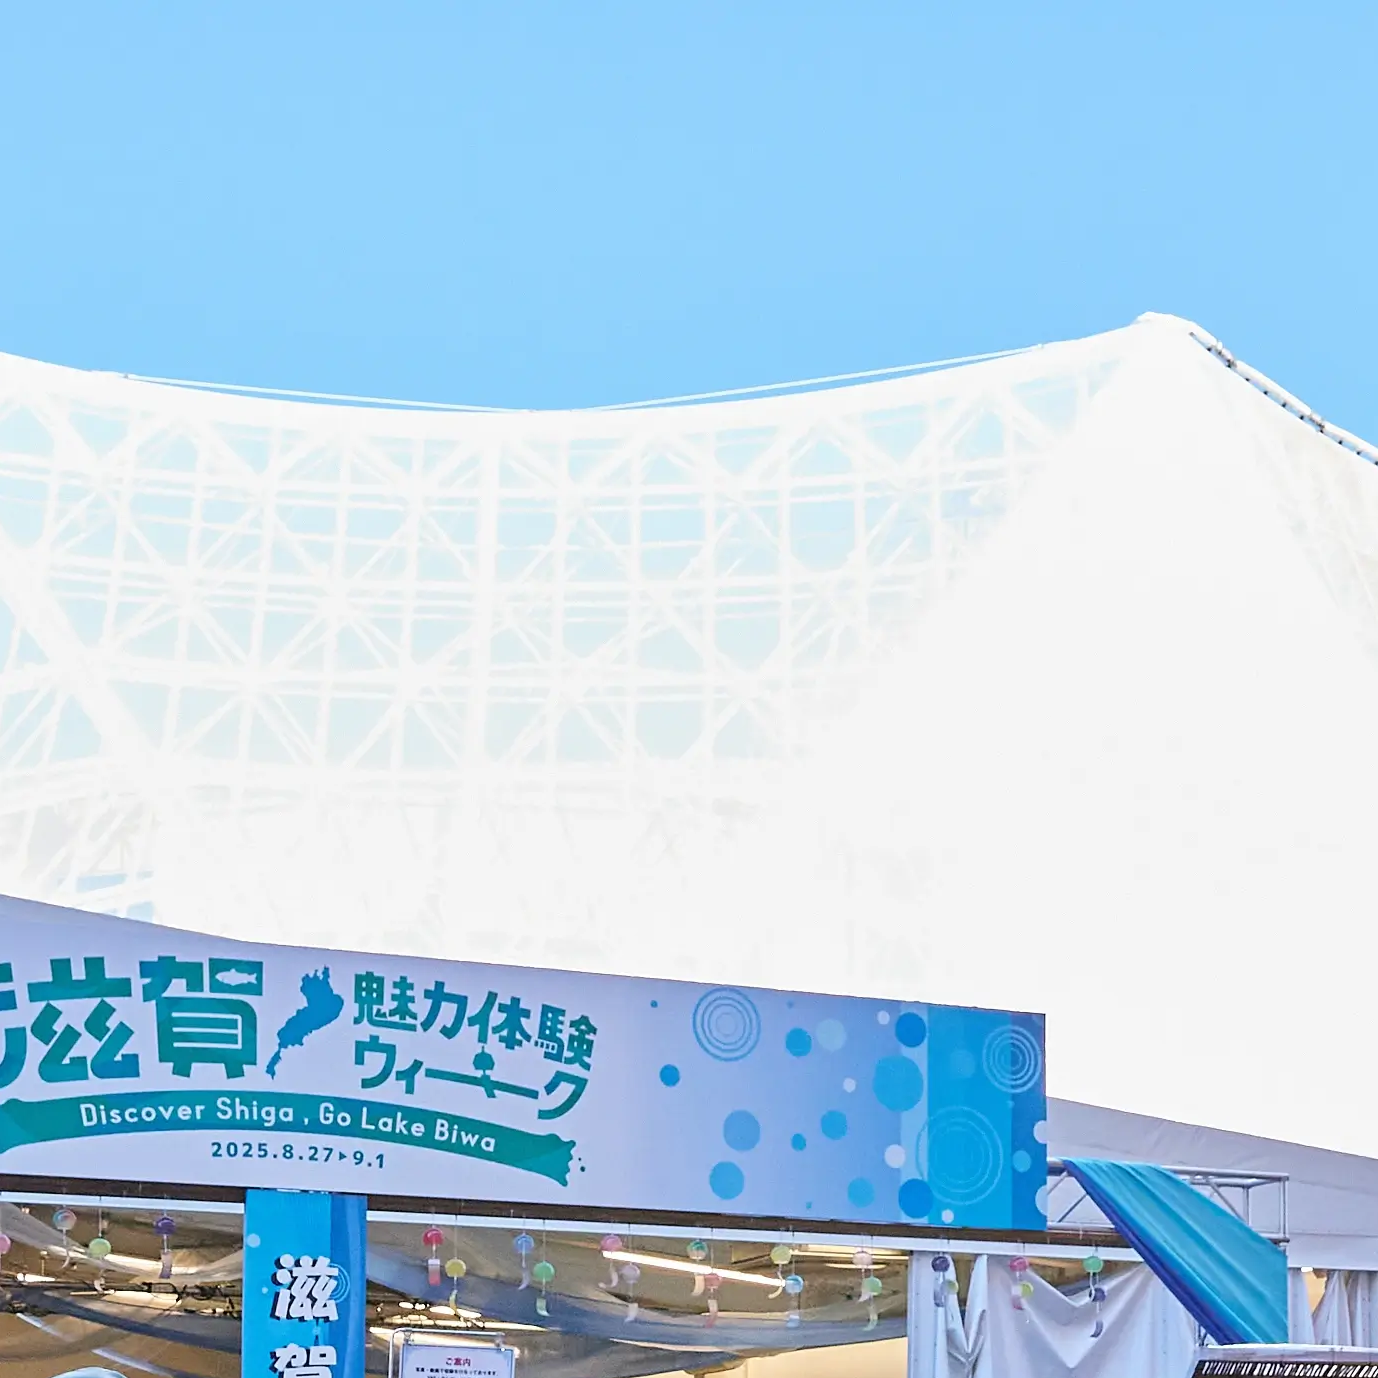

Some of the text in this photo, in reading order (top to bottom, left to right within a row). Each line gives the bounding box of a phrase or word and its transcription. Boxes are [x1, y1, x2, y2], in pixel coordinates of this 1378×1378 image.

[353, 970, 598, 1072] 魅力体験
[353, 1034, 589, 1121] ウィーク
[80, 1102, 203, 1128] Discover
[319, 1103, 351, 1128] Go
[360, 1109, 426, 1139] Lake
[434, 1118, 497, 1153] Biwa
[210, 1140, 385, 1170] 2025.8.27 9.1
